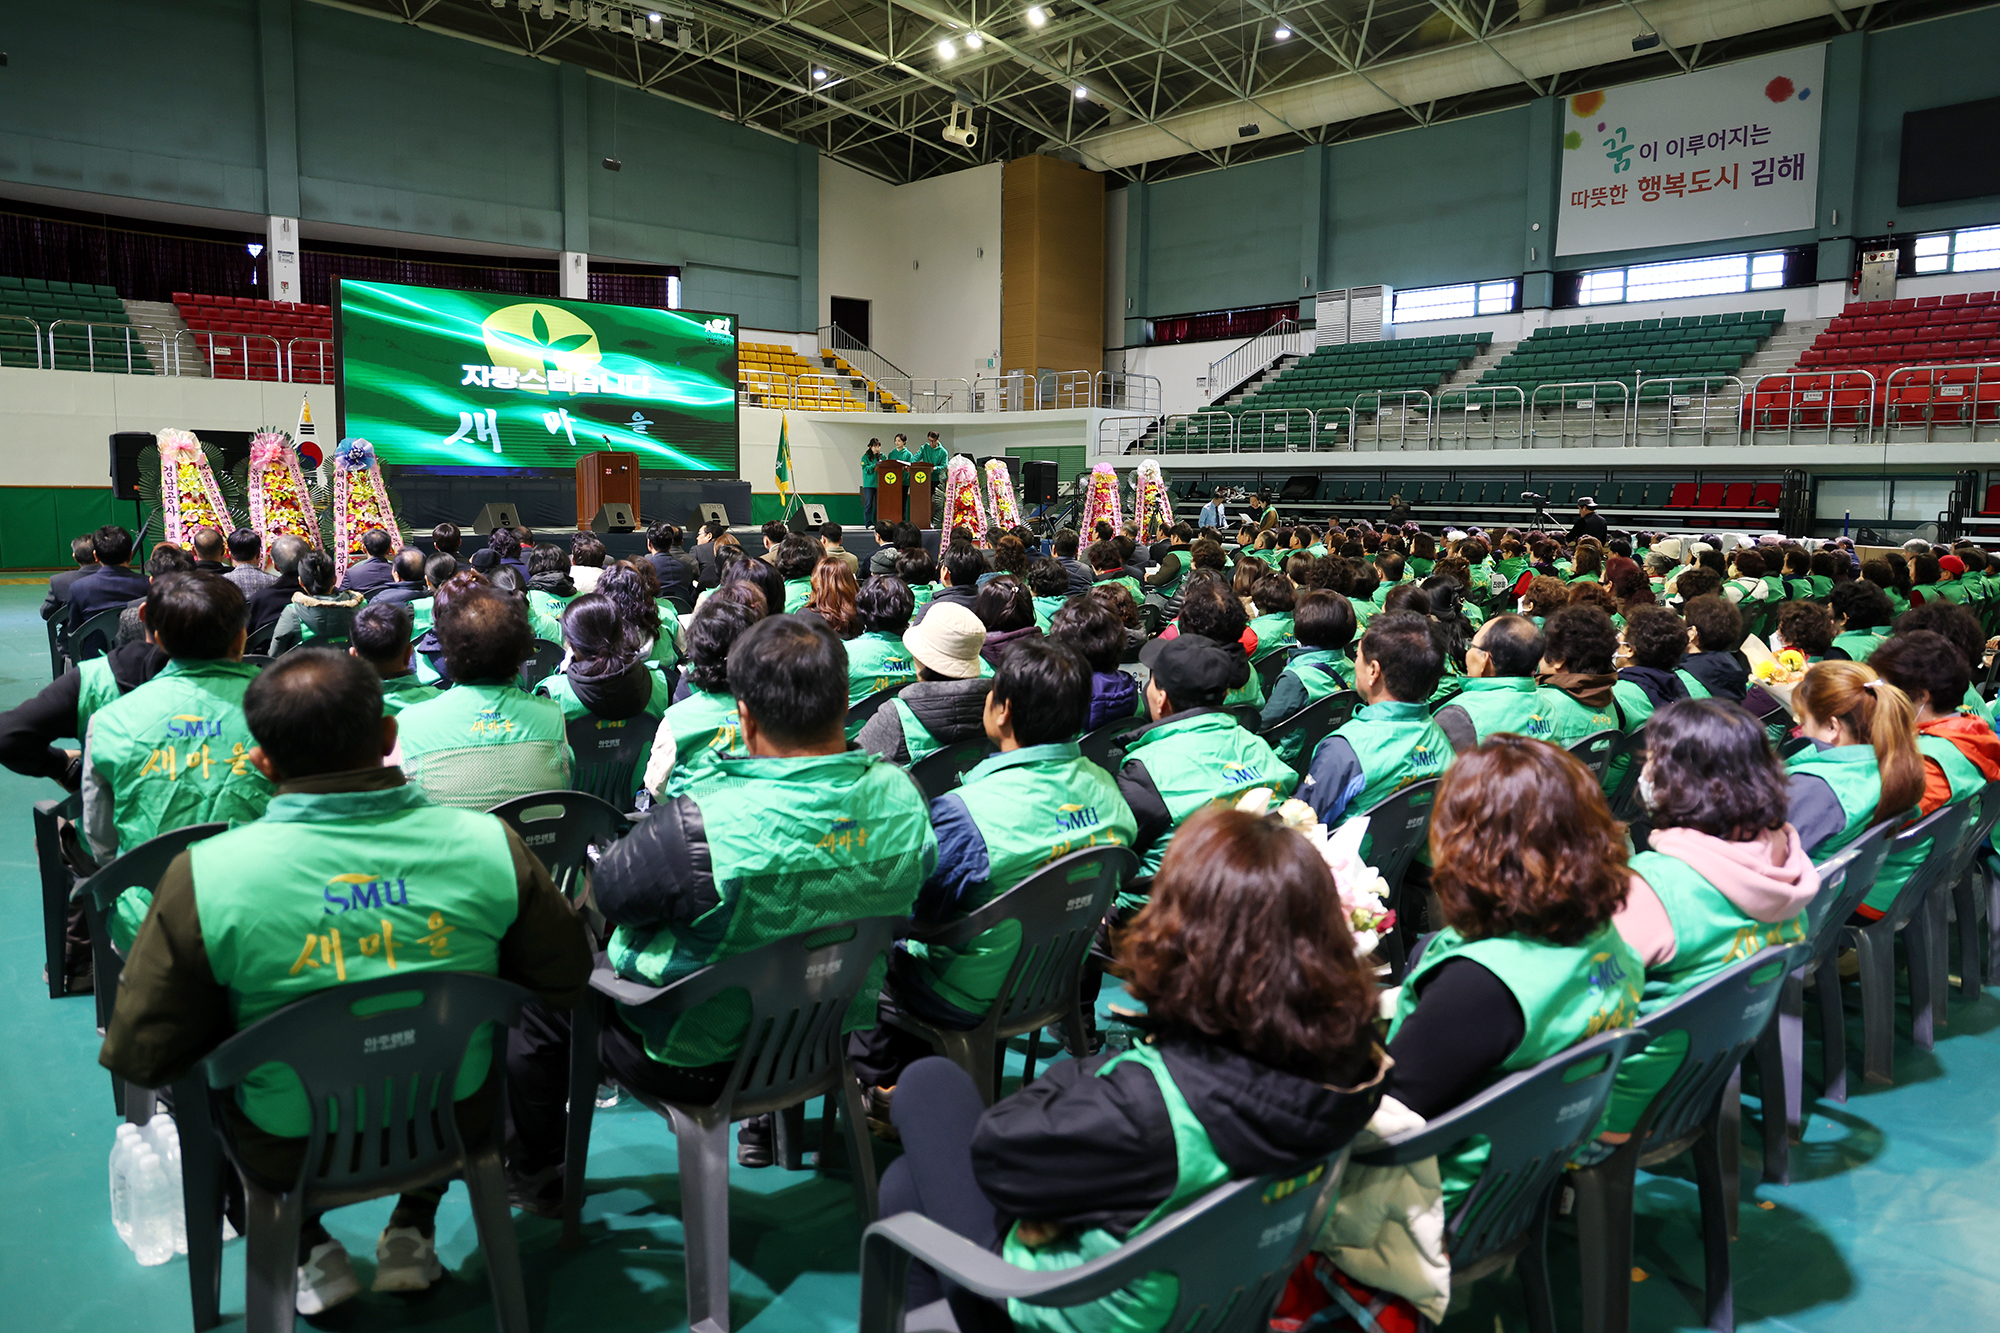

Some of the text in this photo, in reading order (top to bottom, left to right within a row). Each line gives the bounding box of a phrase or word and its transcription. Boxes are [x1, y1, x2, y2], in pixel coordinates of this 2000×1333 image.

[1665, 123, 1772, 158] 이루어지는
[1571, 153, 1805, 209] 따뜻한 행복도시 김해
[460, 364, 652, 396] 자랑스럽습니다
[164, 465, 178, 516] 경남공사
[336, 469, 346, 517] 태인산업
[882, 657, 911, 672] SMU
[166, 716, 222, 738] SMU
[470, 720, 514, 735] 새마을
[1526, 717, 1552, 735] SMU
[139, 742, 250, 781] 새마을
[1411, 748, 1438, 768] SMU
[1221, 765, 1263, 786] SMU
[1055, 806, 1099, 834] SMU
[815, 827, 869, 854] 새마을
[323, 877, 409, 916] SMU
[289, 911, 456, 982] 새마을
